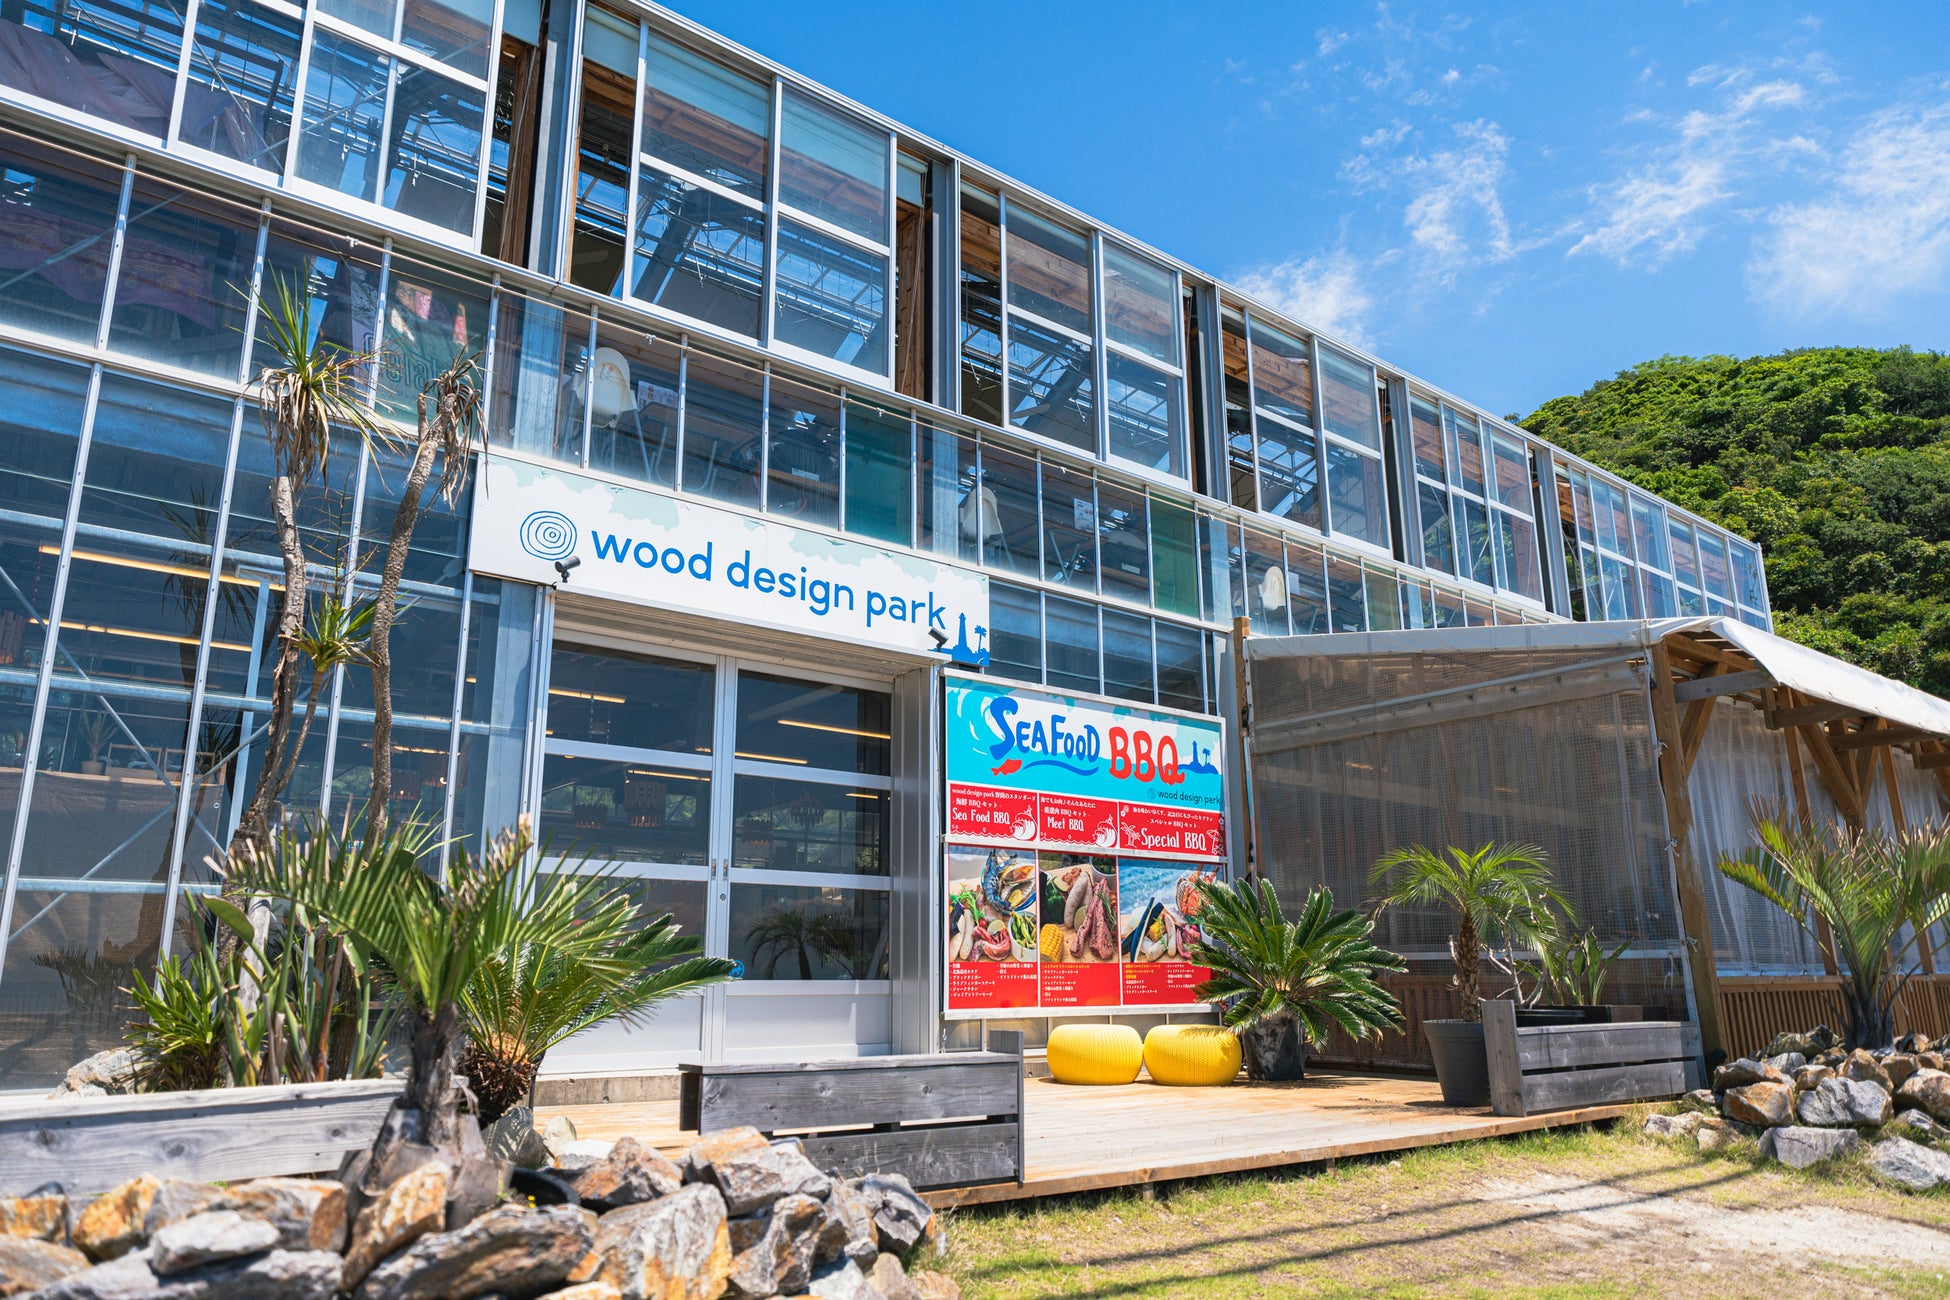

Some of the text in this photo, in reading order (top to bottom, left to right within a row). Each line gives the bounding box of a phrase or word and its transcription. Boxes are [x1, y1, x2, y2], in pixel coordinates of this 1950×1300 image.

[591, 530, 947, 630] wood design park
[1109, 726, 1185, 785] BBQ
[1158, 790, 1221, 807] wood design park
[952, 808, 1010, 825] Sea Food BBQ
[1047, 816, 1084, 832] Meet BBQ
[1141, 828, 1206, 851] Special BBQ
